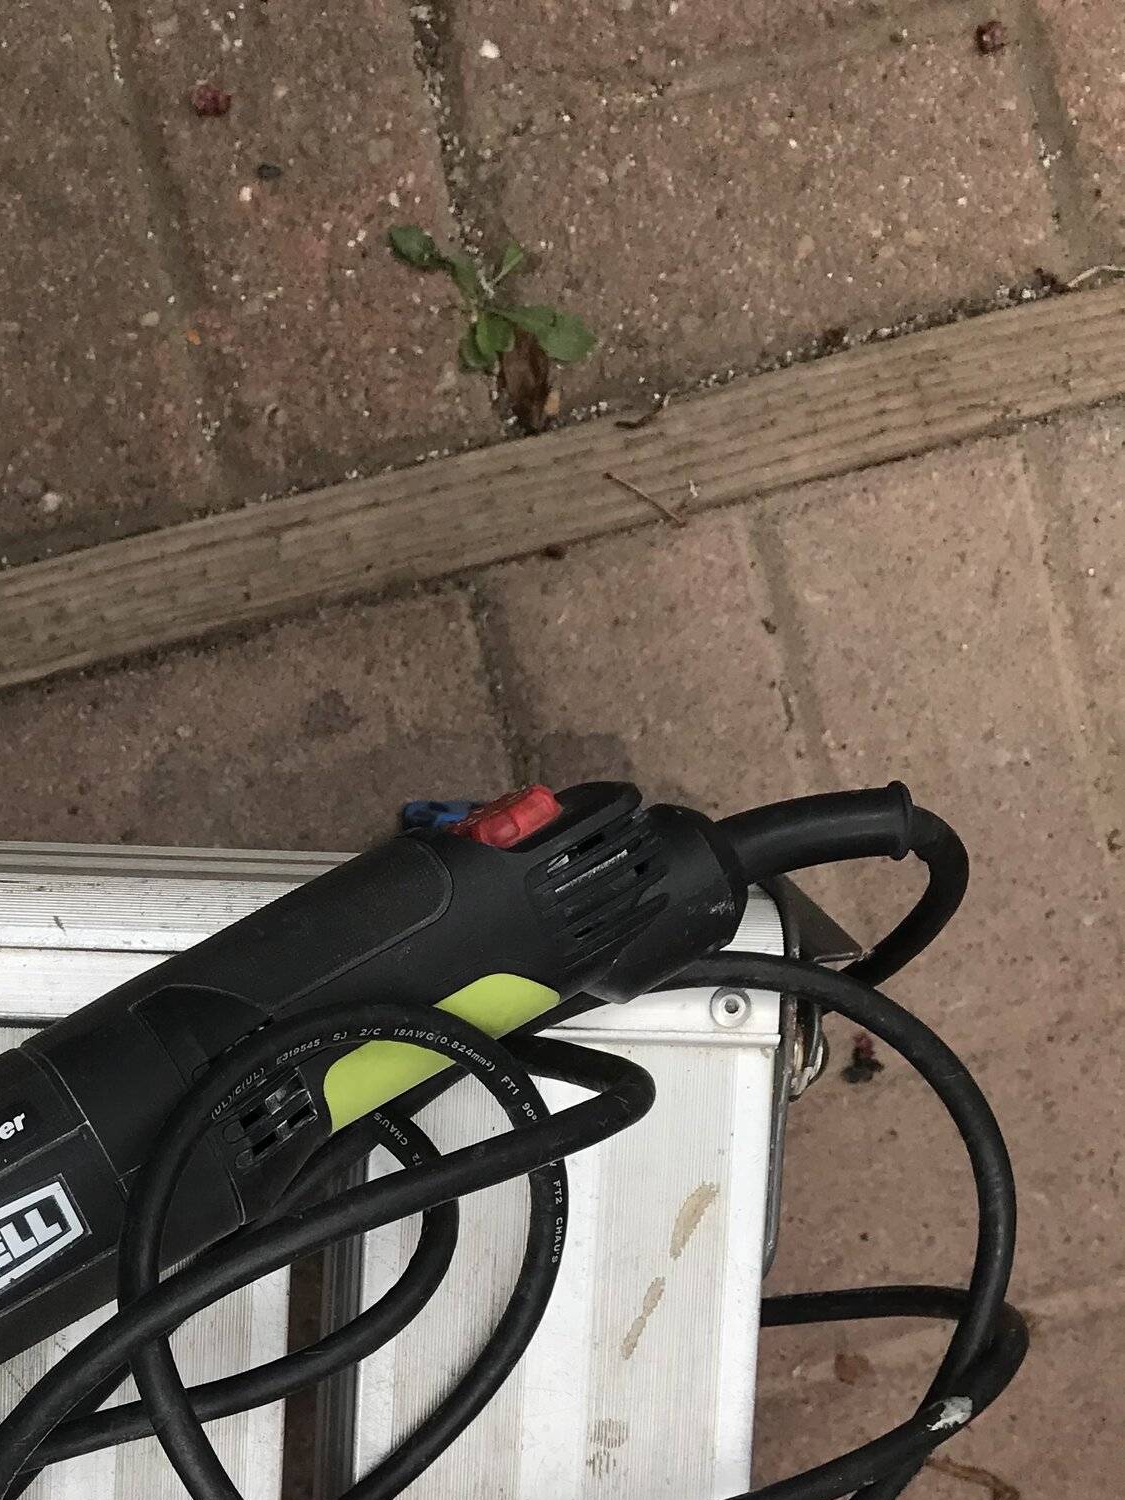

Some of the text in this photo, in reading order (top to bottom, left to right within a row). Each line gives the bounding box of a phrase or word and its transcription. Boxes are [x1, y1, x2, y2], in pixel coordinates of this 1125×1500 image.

[333, 1031, 347, 1041] SJ
[359, 1027, 381, 1037] 2/C
[501, 1075, 520, 1097] FT1
[553, 1180, 562, 1205] FT2
[551, 1216, 564, 1264] CHAU'S
